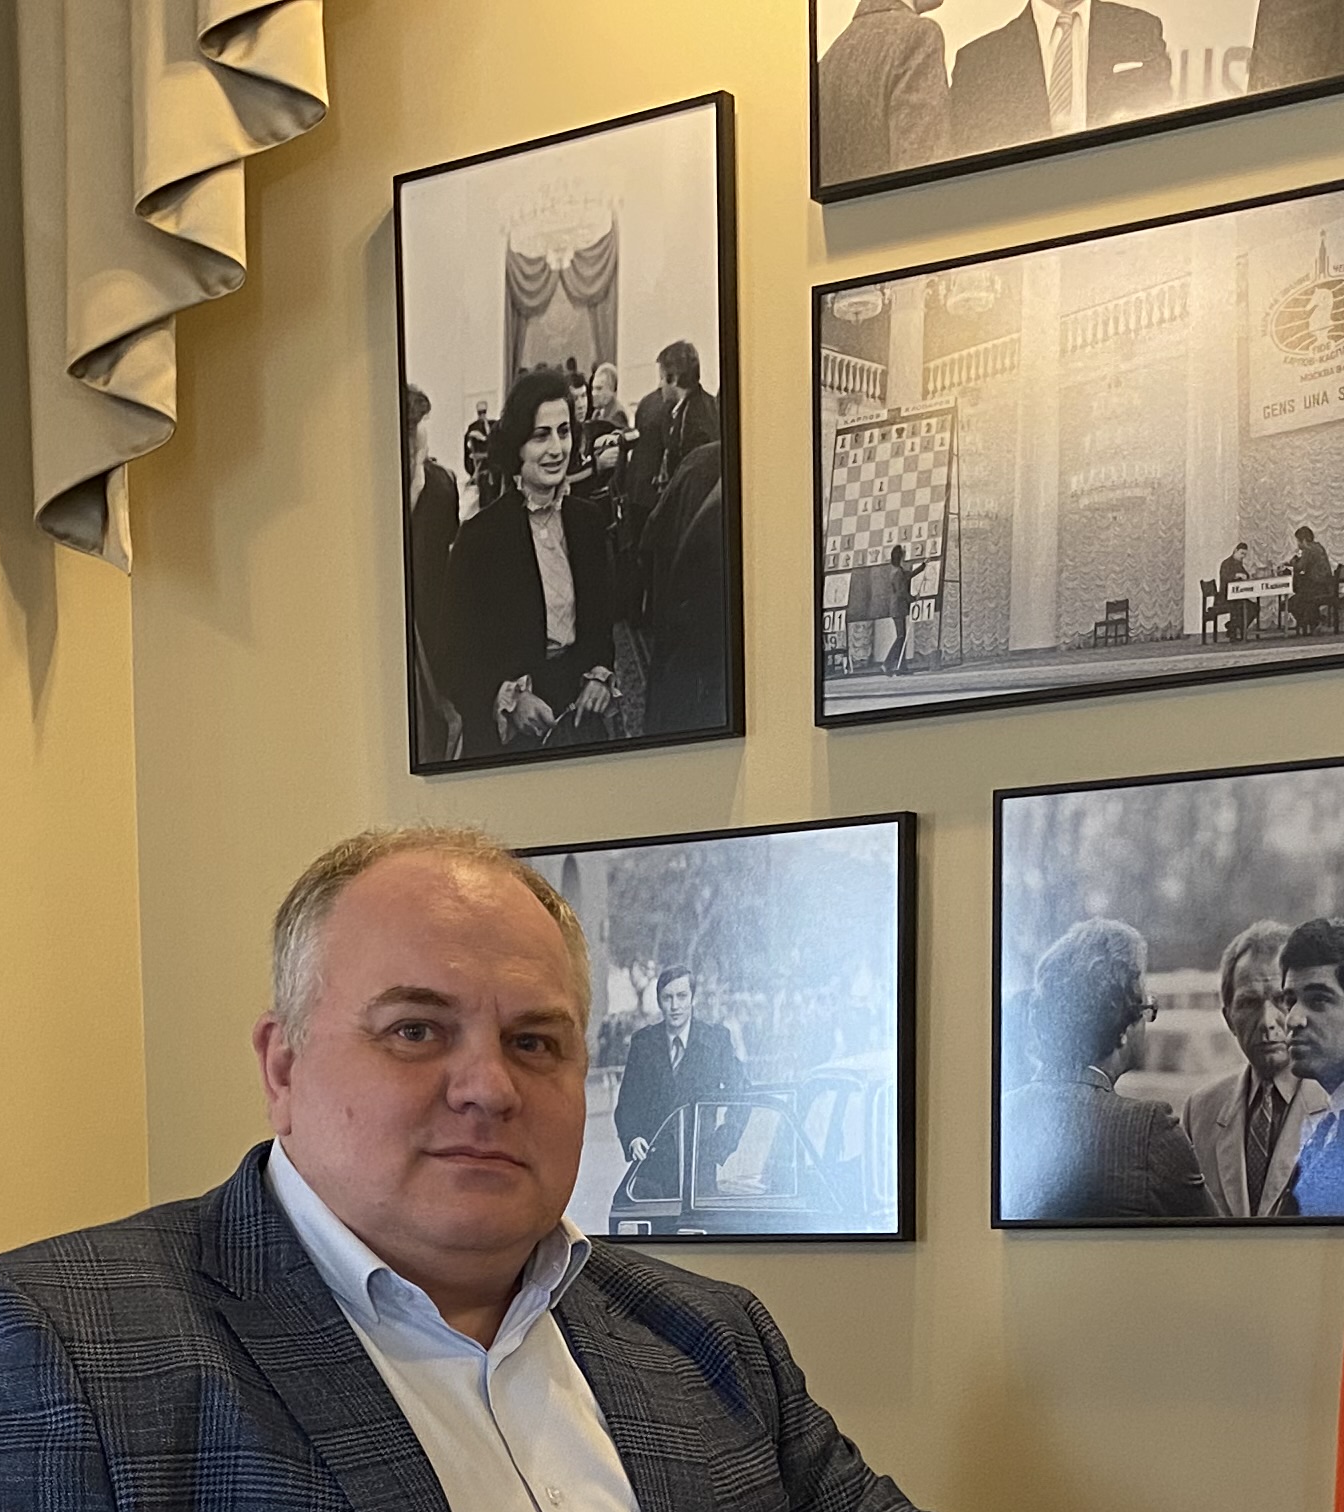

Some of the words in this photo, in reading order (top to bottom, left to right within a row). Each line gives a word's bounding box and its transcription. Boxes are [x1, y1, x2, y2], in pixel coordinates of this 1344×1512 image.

[1262, 399, 1296, 419] GENS
[1303, 391, 1329, 410] UNA
[911, 602, 932, 621] 01
